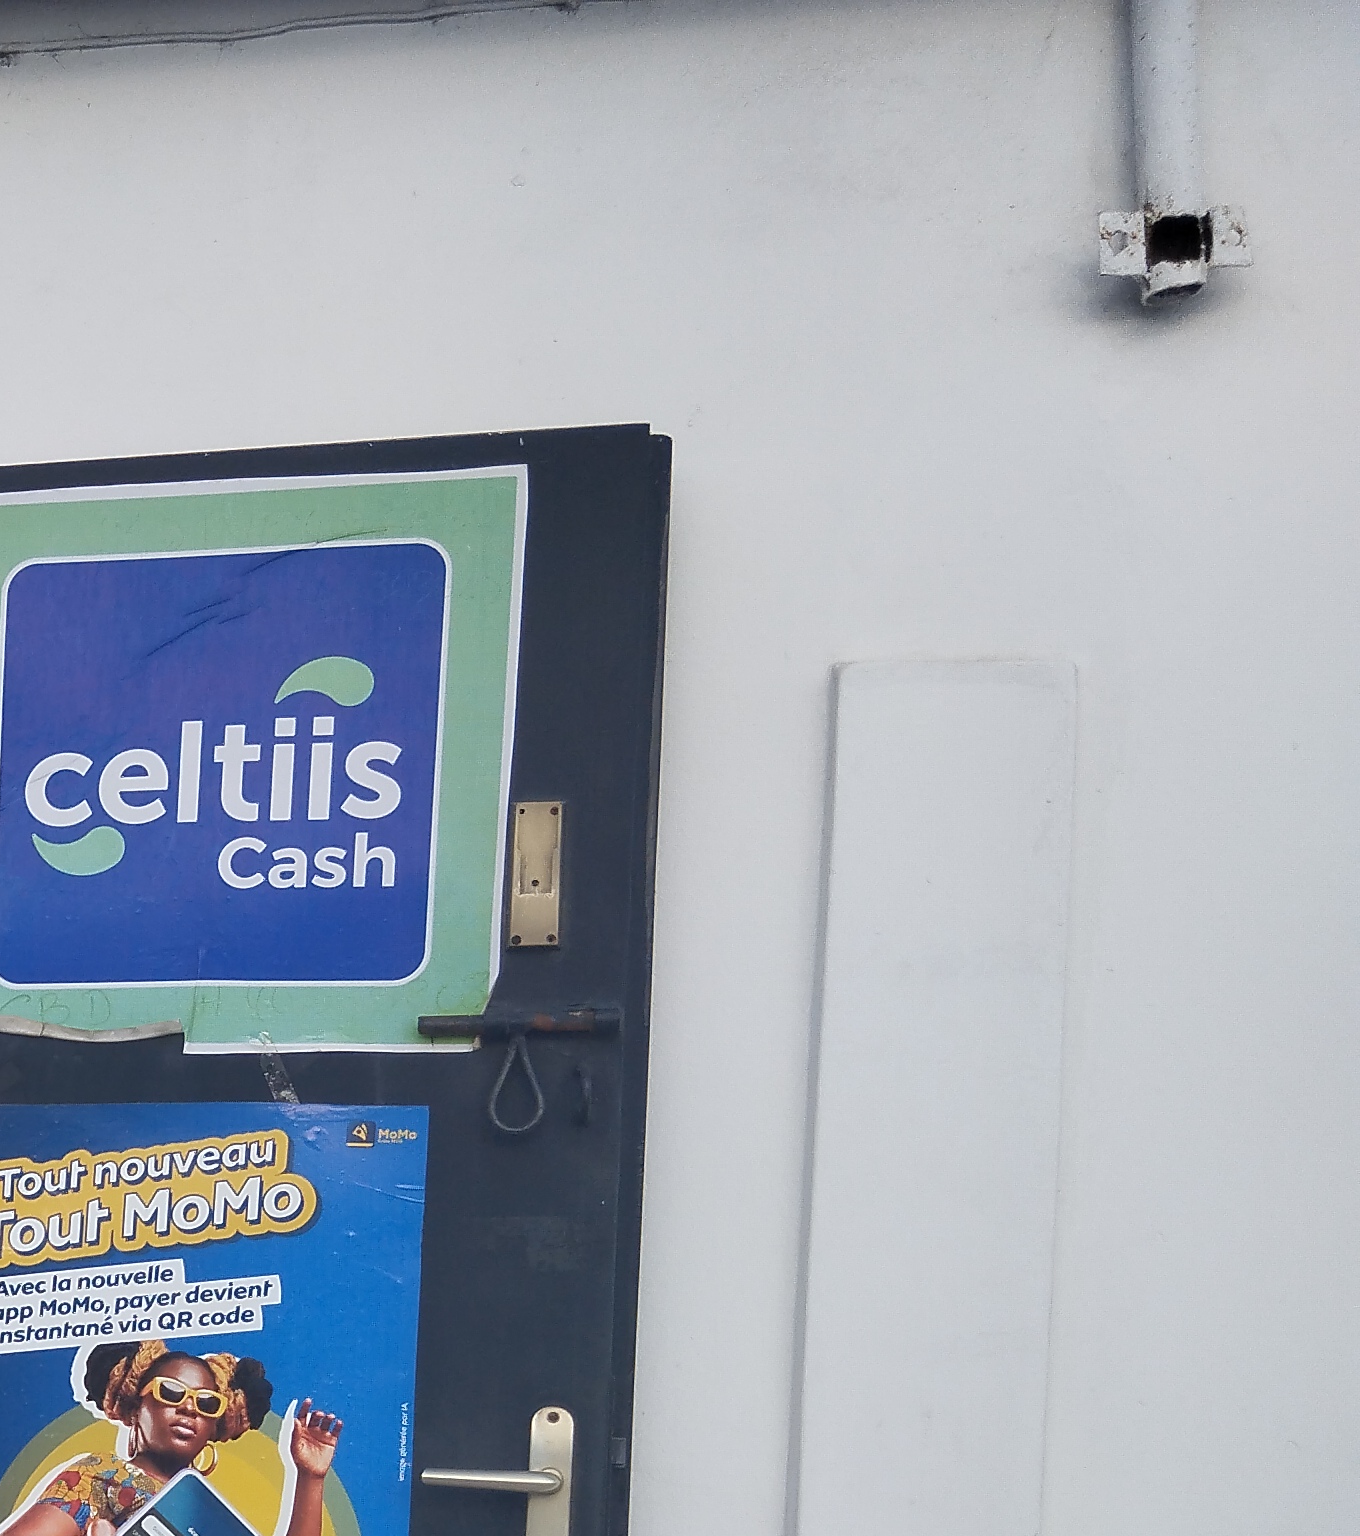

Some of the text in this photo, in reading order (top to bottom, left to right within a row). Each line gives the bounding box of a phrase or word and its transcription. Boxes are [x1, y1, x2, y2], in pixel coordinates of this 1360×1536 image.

[25, 715, 403, 828] celtiis
[217, 831, 397, 890] Cash
[377, 1128, 418, 1141] MoMo
[92, 1136, 277, 1190] nouveau
[120, 1176, 306, 1243] MoMo
[38, 1296, 111, 1320] MoMo,
[113, 1289, 181, 1316] payer
[185, 1281, 273, 1304] devient
[51, 1275, 73, 1293] la
[77, 1265, 175, 1291] nouvelle
[118, 1314, 152, 1335] via
[157, 1310, 193, 1334] QR
[197, 1306, 256, 1328] code
